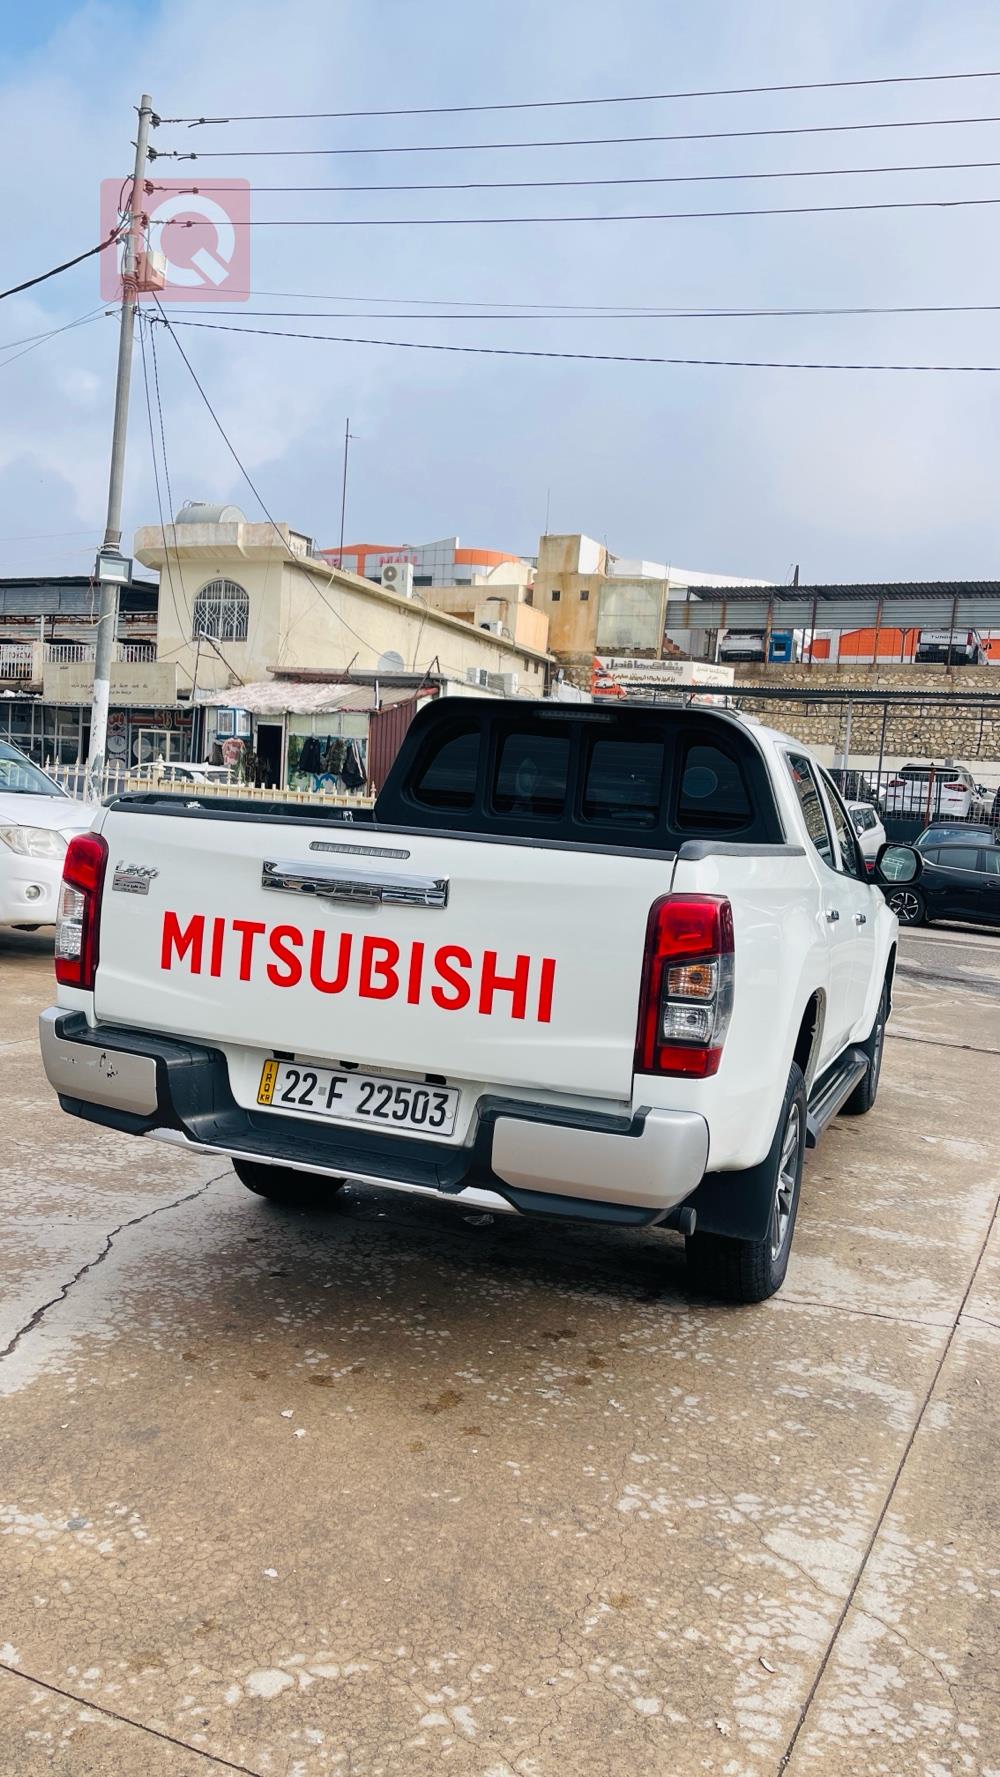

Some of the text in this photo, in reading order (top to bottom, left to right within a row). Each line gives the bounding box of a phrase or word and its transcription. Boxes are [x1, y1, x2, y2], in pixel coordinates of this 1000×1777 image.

[160, 911, 556, 1023] MITSUBISHI
[281, 1069, 449, 1127] 22 F 22503
